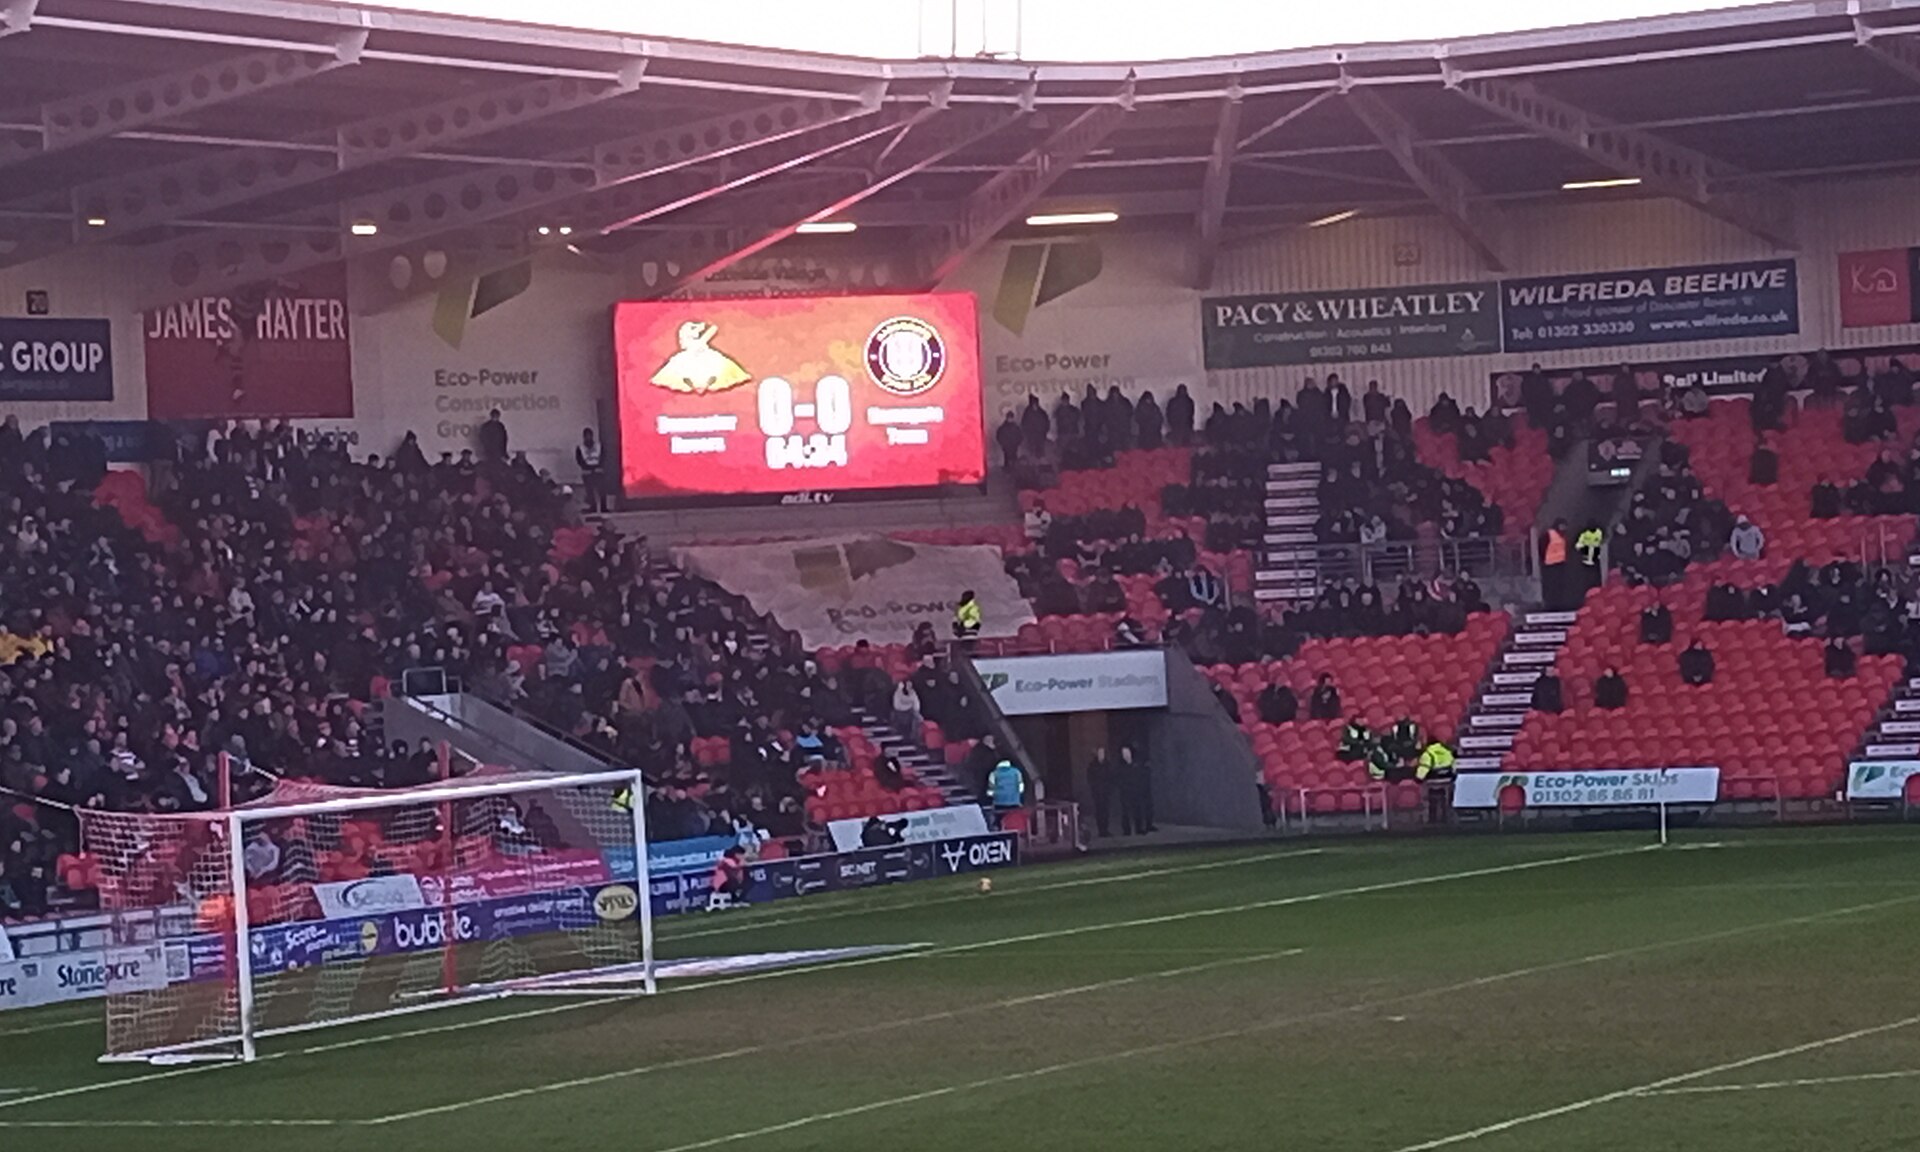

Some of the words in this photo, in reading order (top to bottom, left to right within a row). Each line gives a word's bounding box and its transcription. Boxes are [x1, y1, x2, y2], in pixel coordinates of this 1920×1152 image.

[1508, 278, 1656, 306] WILFREDA
[1664, 268, 1788, 296] BEEHIVE
[149, 297, 233, 339] JAMES
[1216, 302, 1289, 328] PACY
[1292, 301, 1314, 323] &
[1316, 291, 1485, 320] WHEATLEY
[1538, 324, 1579, 338] 01302
[11, 341, 103, 372] GROUP
[996, 352, 1111, 373] Eco-Power
[435, 368, 538, 387] Eco-Power
[435, 393, 560, 413] Construction
[1015, 677, 1093, 693] Eco-Power
[1534, 773, 1628, 788] Eco-Power
[1532, 788, 1583, 804] 01302
[969, 839, 1012, 866] OXEN
[57, 960, 141, 988] Stoneacre
